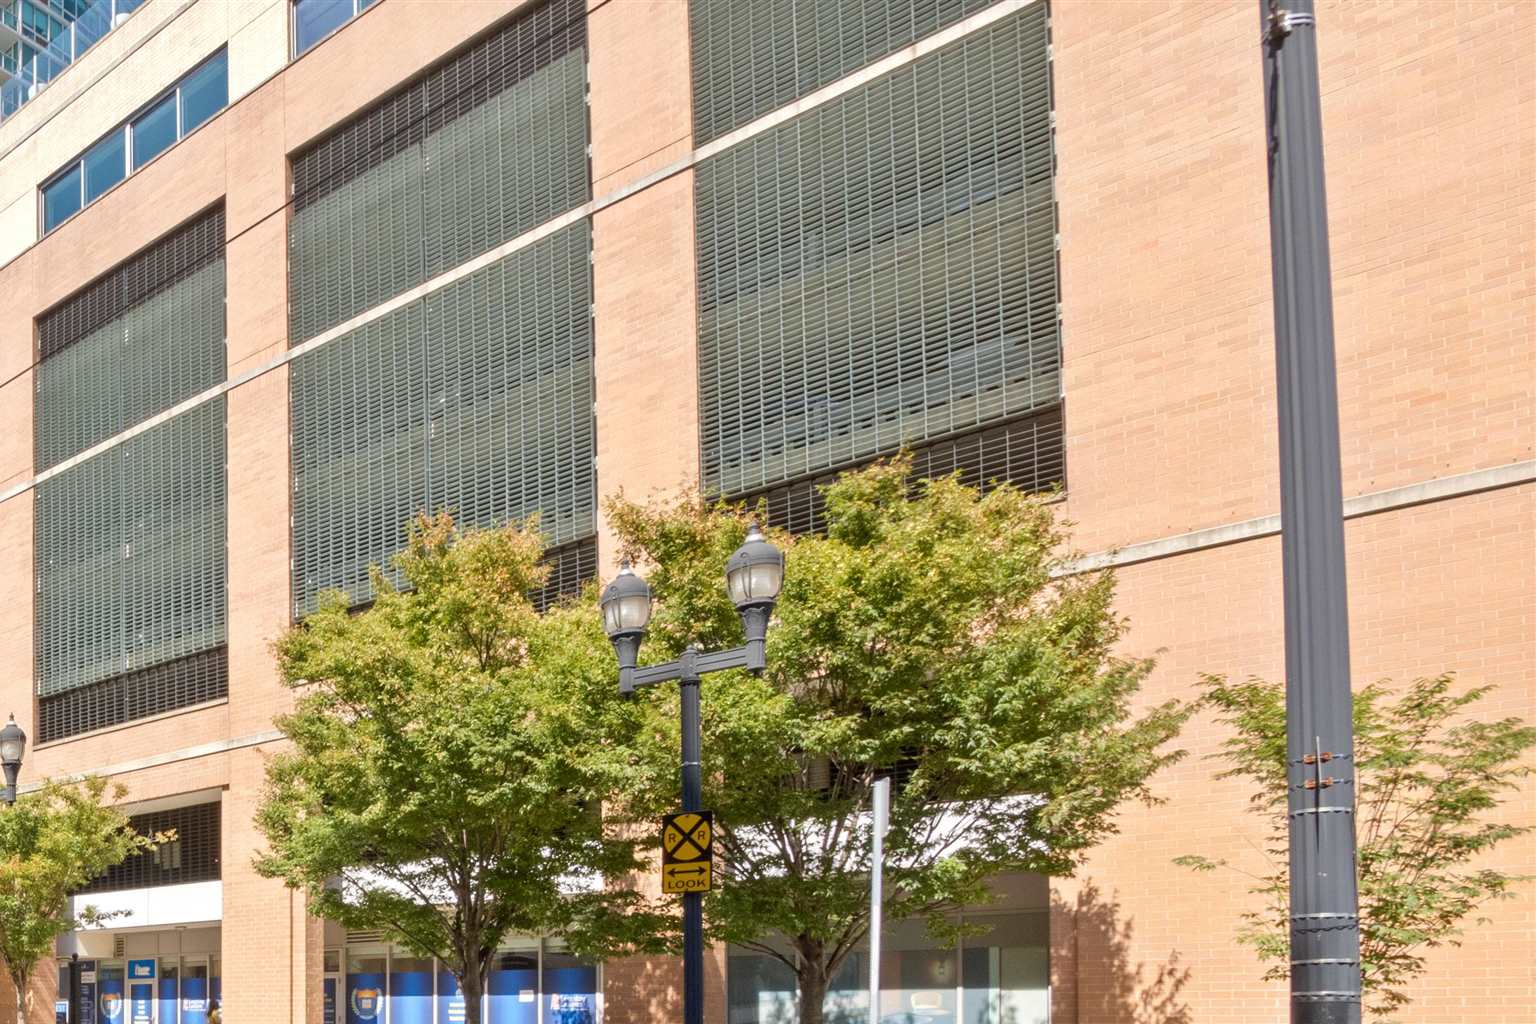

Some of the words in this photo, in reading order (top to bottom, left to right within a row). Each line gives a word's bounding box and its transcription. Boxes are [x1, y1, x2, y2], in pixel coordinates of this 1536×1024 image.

[668, 833, 676, 843] R
[697, 830, 706, 841] R
[668, 880, 706, 889] LOOK
